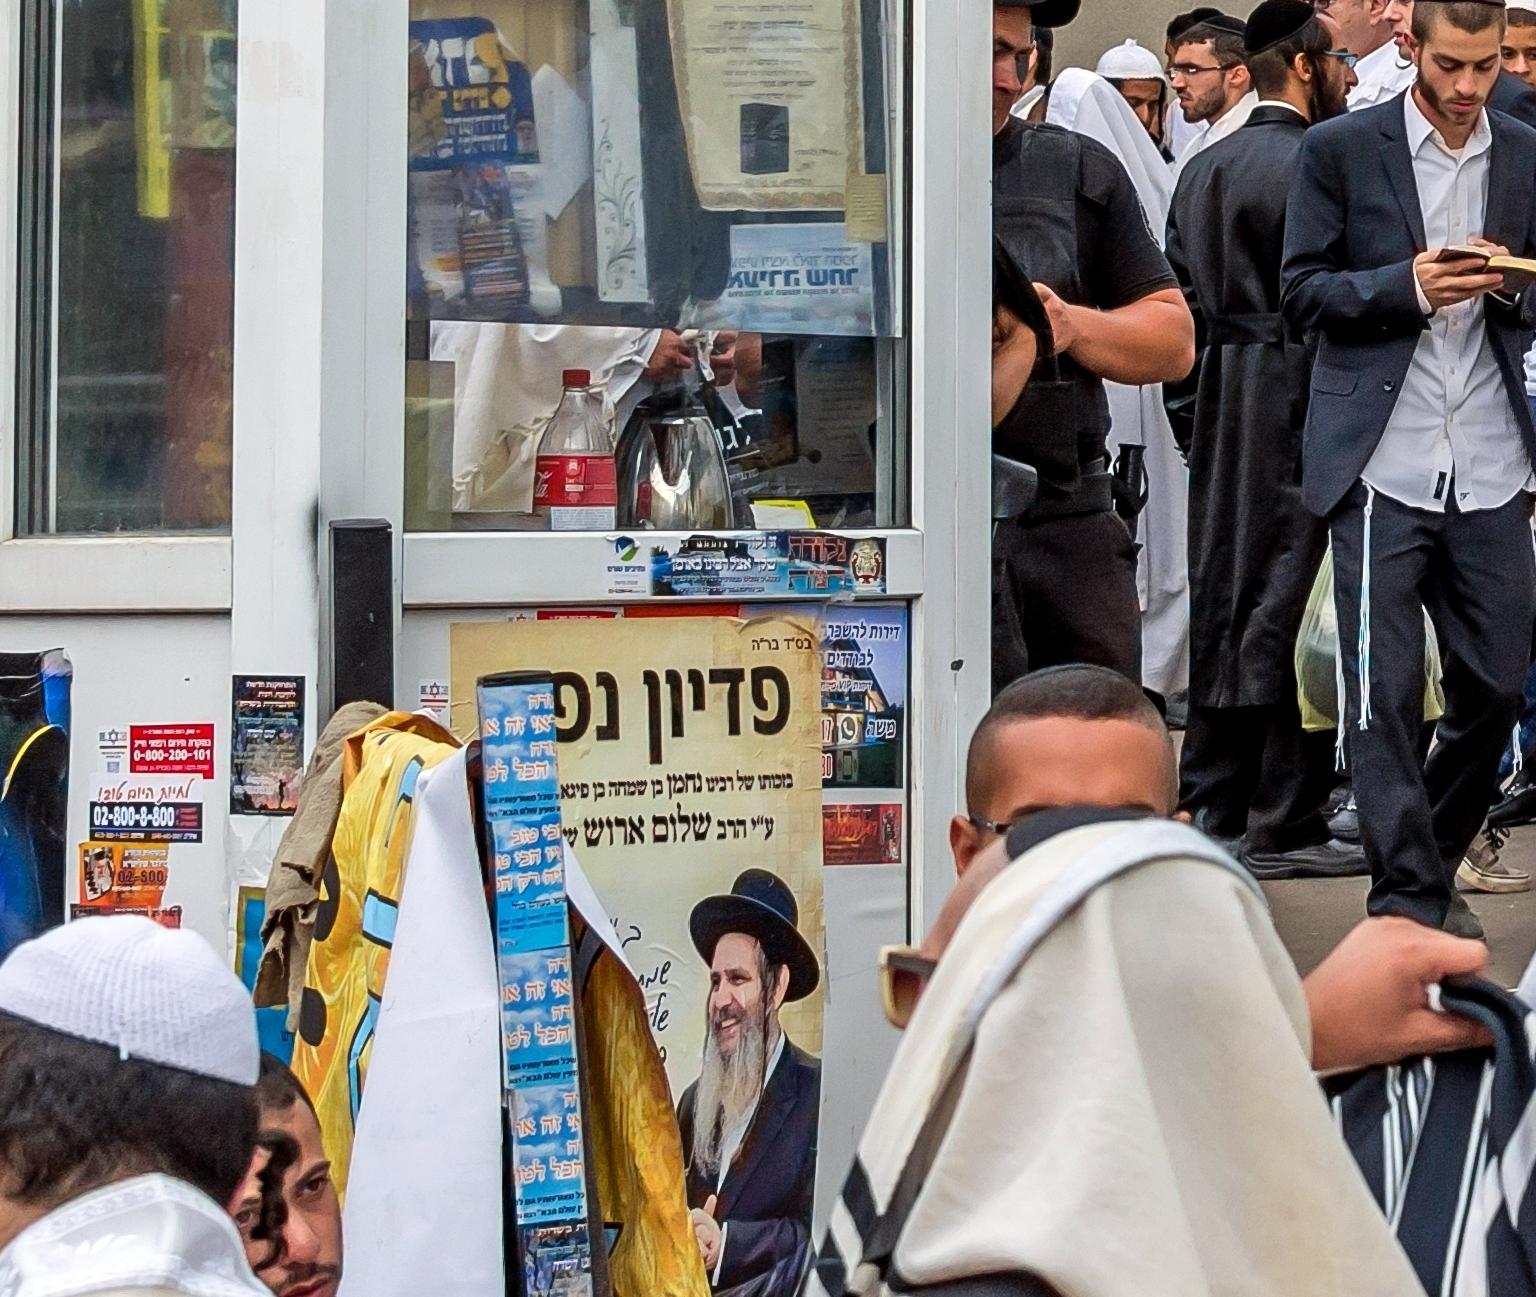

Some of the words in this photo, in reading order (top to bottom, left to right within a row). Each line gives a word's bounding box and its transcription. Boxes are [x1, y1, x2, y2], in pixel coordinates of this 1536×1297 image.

[869, 623, 901, 641] דירות
[551, 670, 620, 743] נפ
[642, 665, 791, 766] פדיון
[866, 718, 897, 740] משה
[133, 748, 212, 762] 0-800-200-101
[559, 782, 590, 801] פיגא
[608, 779, 648, 798] שמחה
[650, 778, 664, 800] בן
[666, 771, 703, 801] נחמן
[705, 775, 735, 793] רבינו
[736, 770, 755, 791] של
[757, 772, 794, 790] בזכותו
[592, 782, 606, 803] בן
[93, 805, 175, 827] 02-800-8-800
[651, 802, 713, 844] שלום
[583, 815, 645, 848] ארוש
[716, 817, 747, 841] הרב
